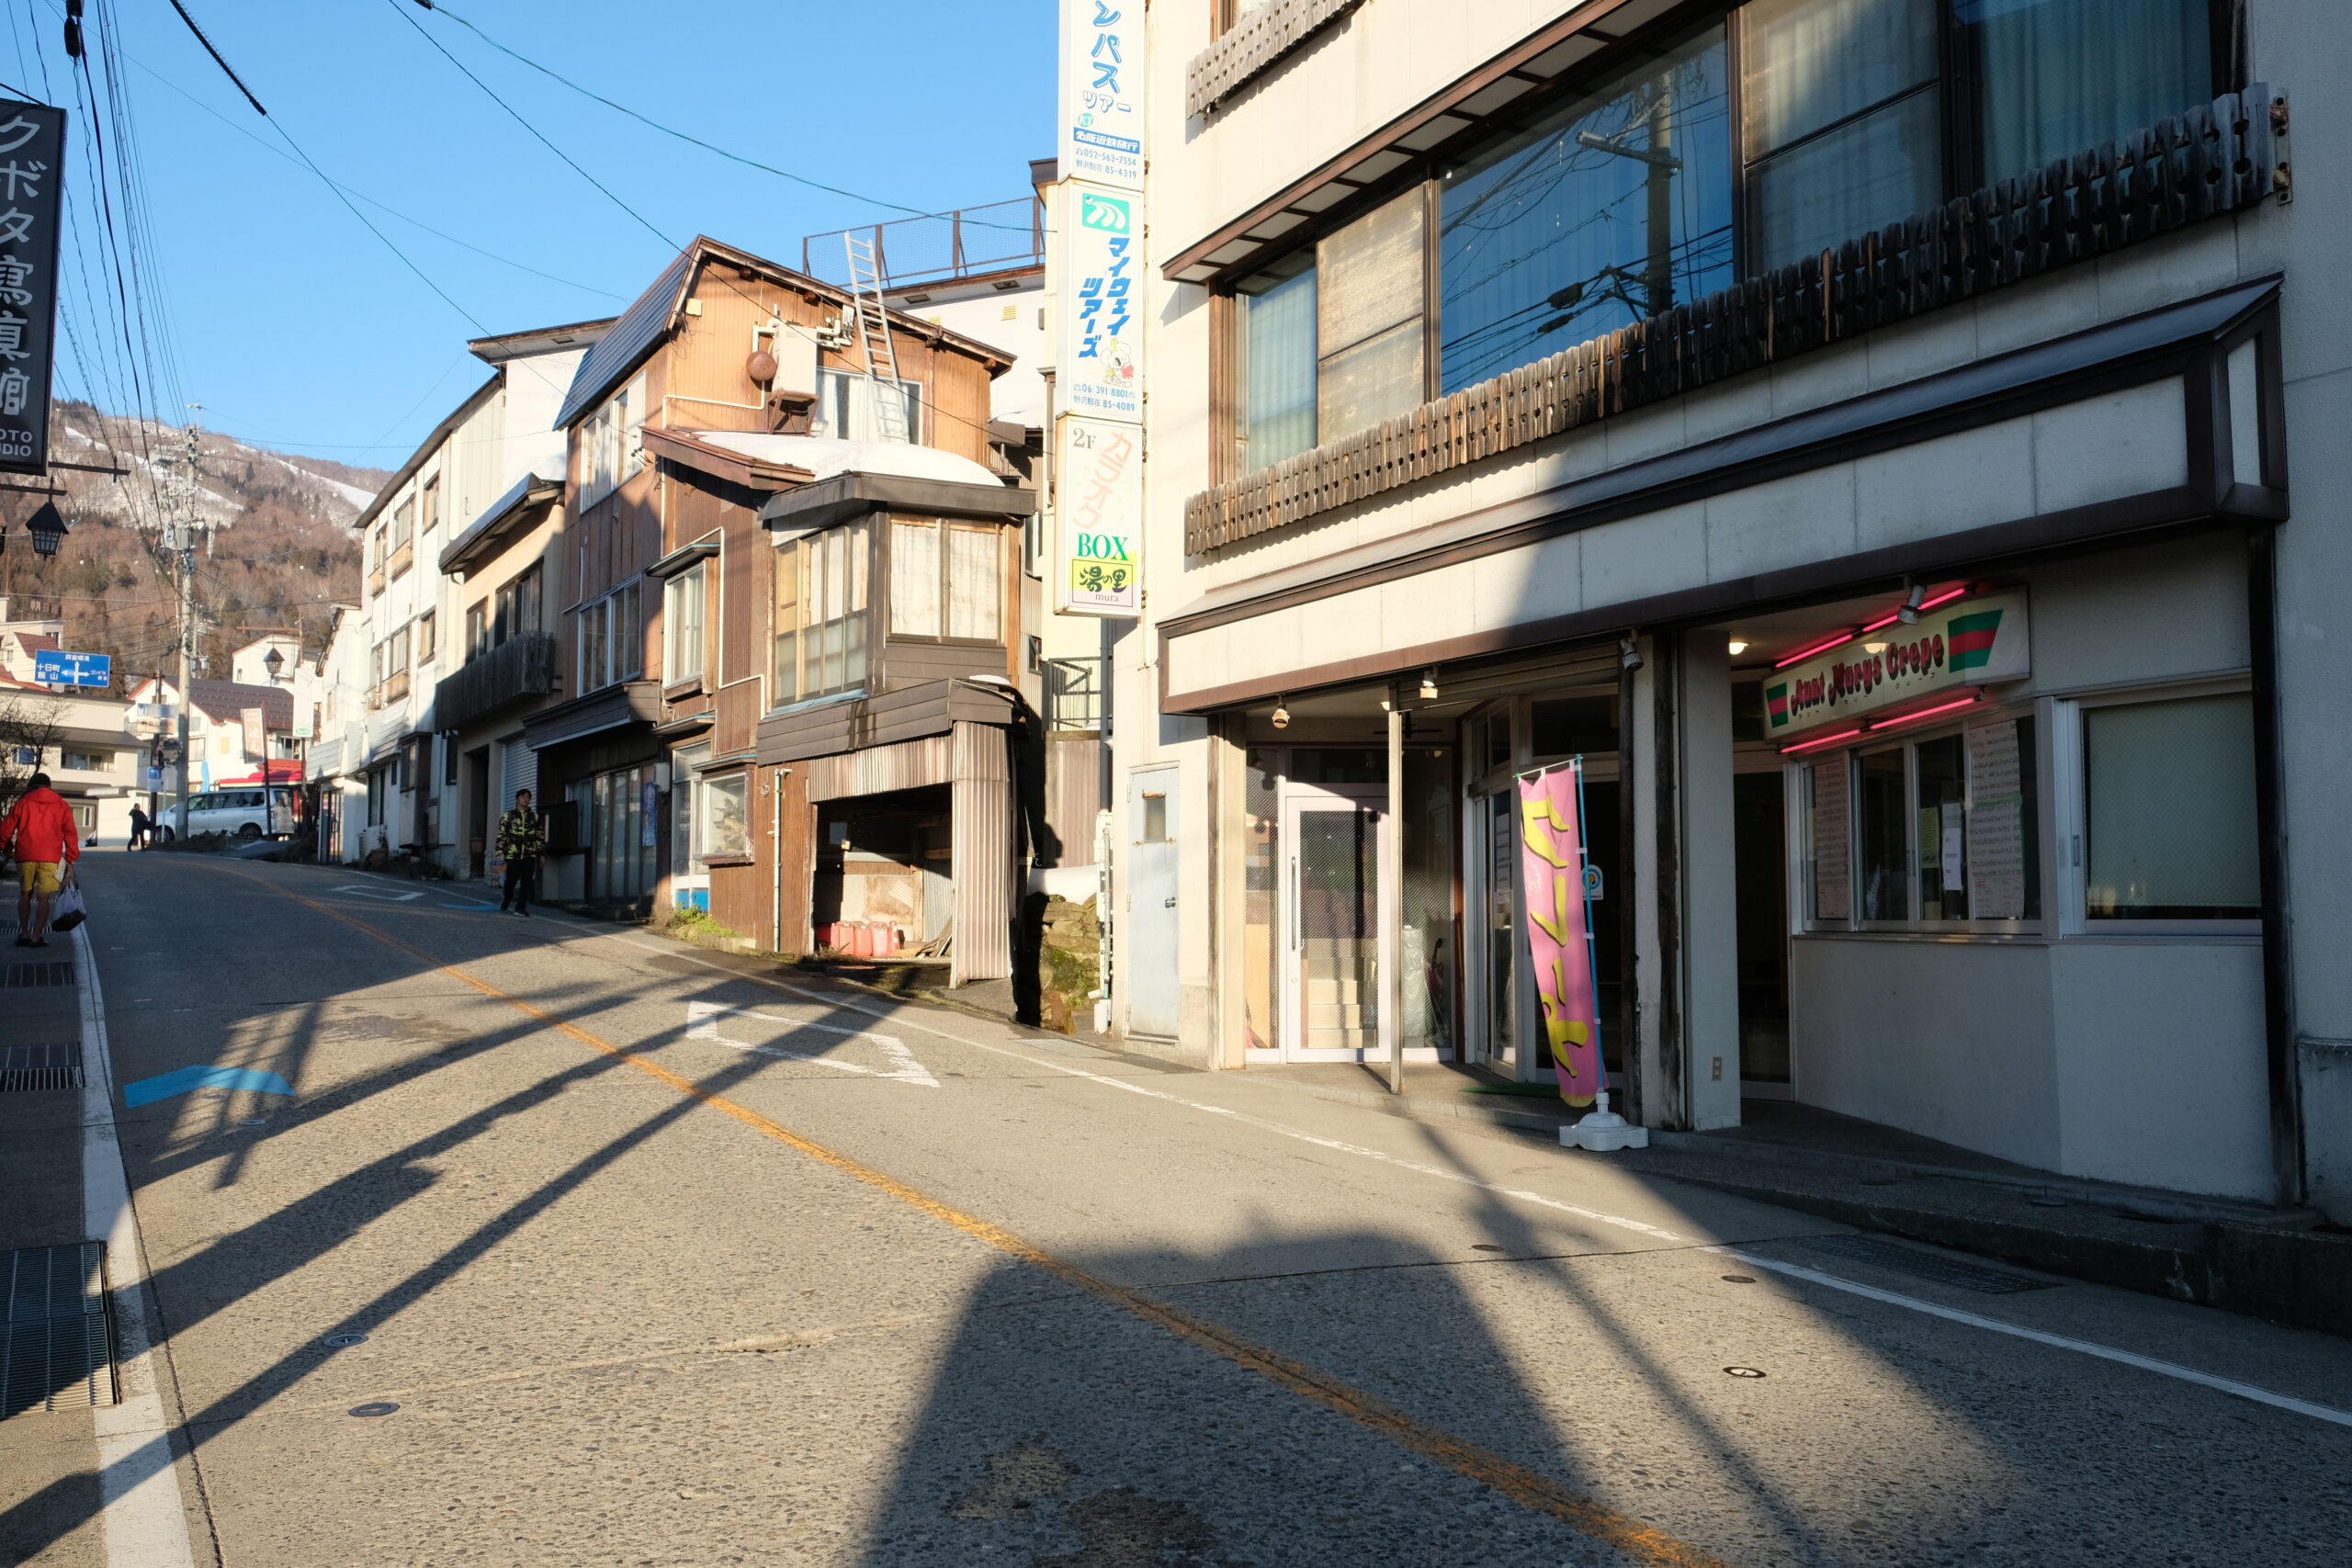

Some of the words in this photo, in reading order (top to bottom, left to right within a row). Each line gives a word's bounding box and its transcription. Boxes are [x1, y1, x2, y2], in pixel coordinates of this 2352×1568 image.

[1083, 90, 1131, 113] ツアー
[1105, 165, 1137, 179] 85-4319
[1106, 237, 1131, 335] マイウェイ
[1078, 277, 1103, 357] ツアーズ
[1102, 399, 1136, 412] 85-4089
[1073, 427, 1096, 449] 2F
[1077, 532, 1129, 561] BOX
[1079, 566, 1127, 593] 湯の里
[37, 663, 61, 672] 十日町
[1791, 671, 1826, 716] Aunt
[1886, 634, 1945, 680] Crepe
